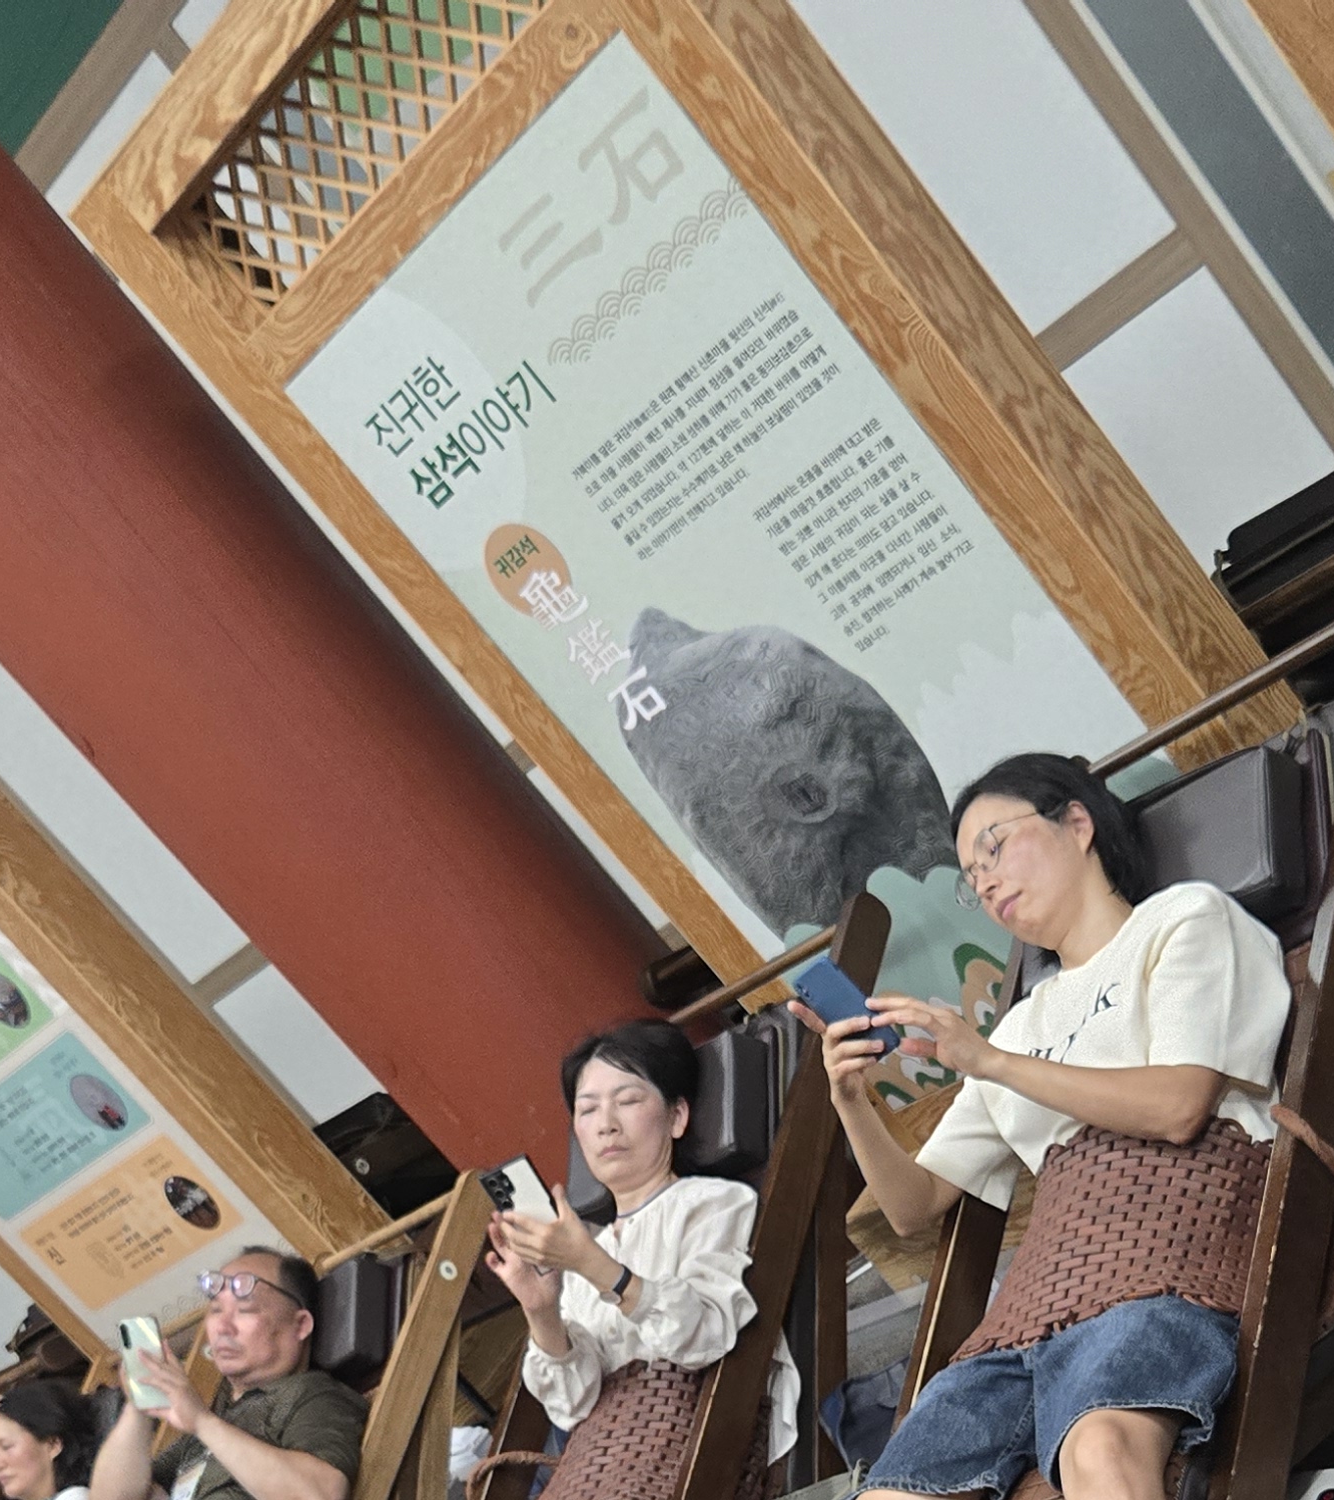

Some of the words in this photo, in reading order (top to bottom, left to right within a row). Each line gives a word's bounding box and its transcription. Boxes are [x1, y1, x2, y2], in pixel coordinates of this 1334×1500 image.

[498, 84, 685, 309] 三石
[364, 356, 462, 458] 진귀한
[409, 360, 557, 511] 삼석이야기
[493, 535, 541, 579] 귀감석
